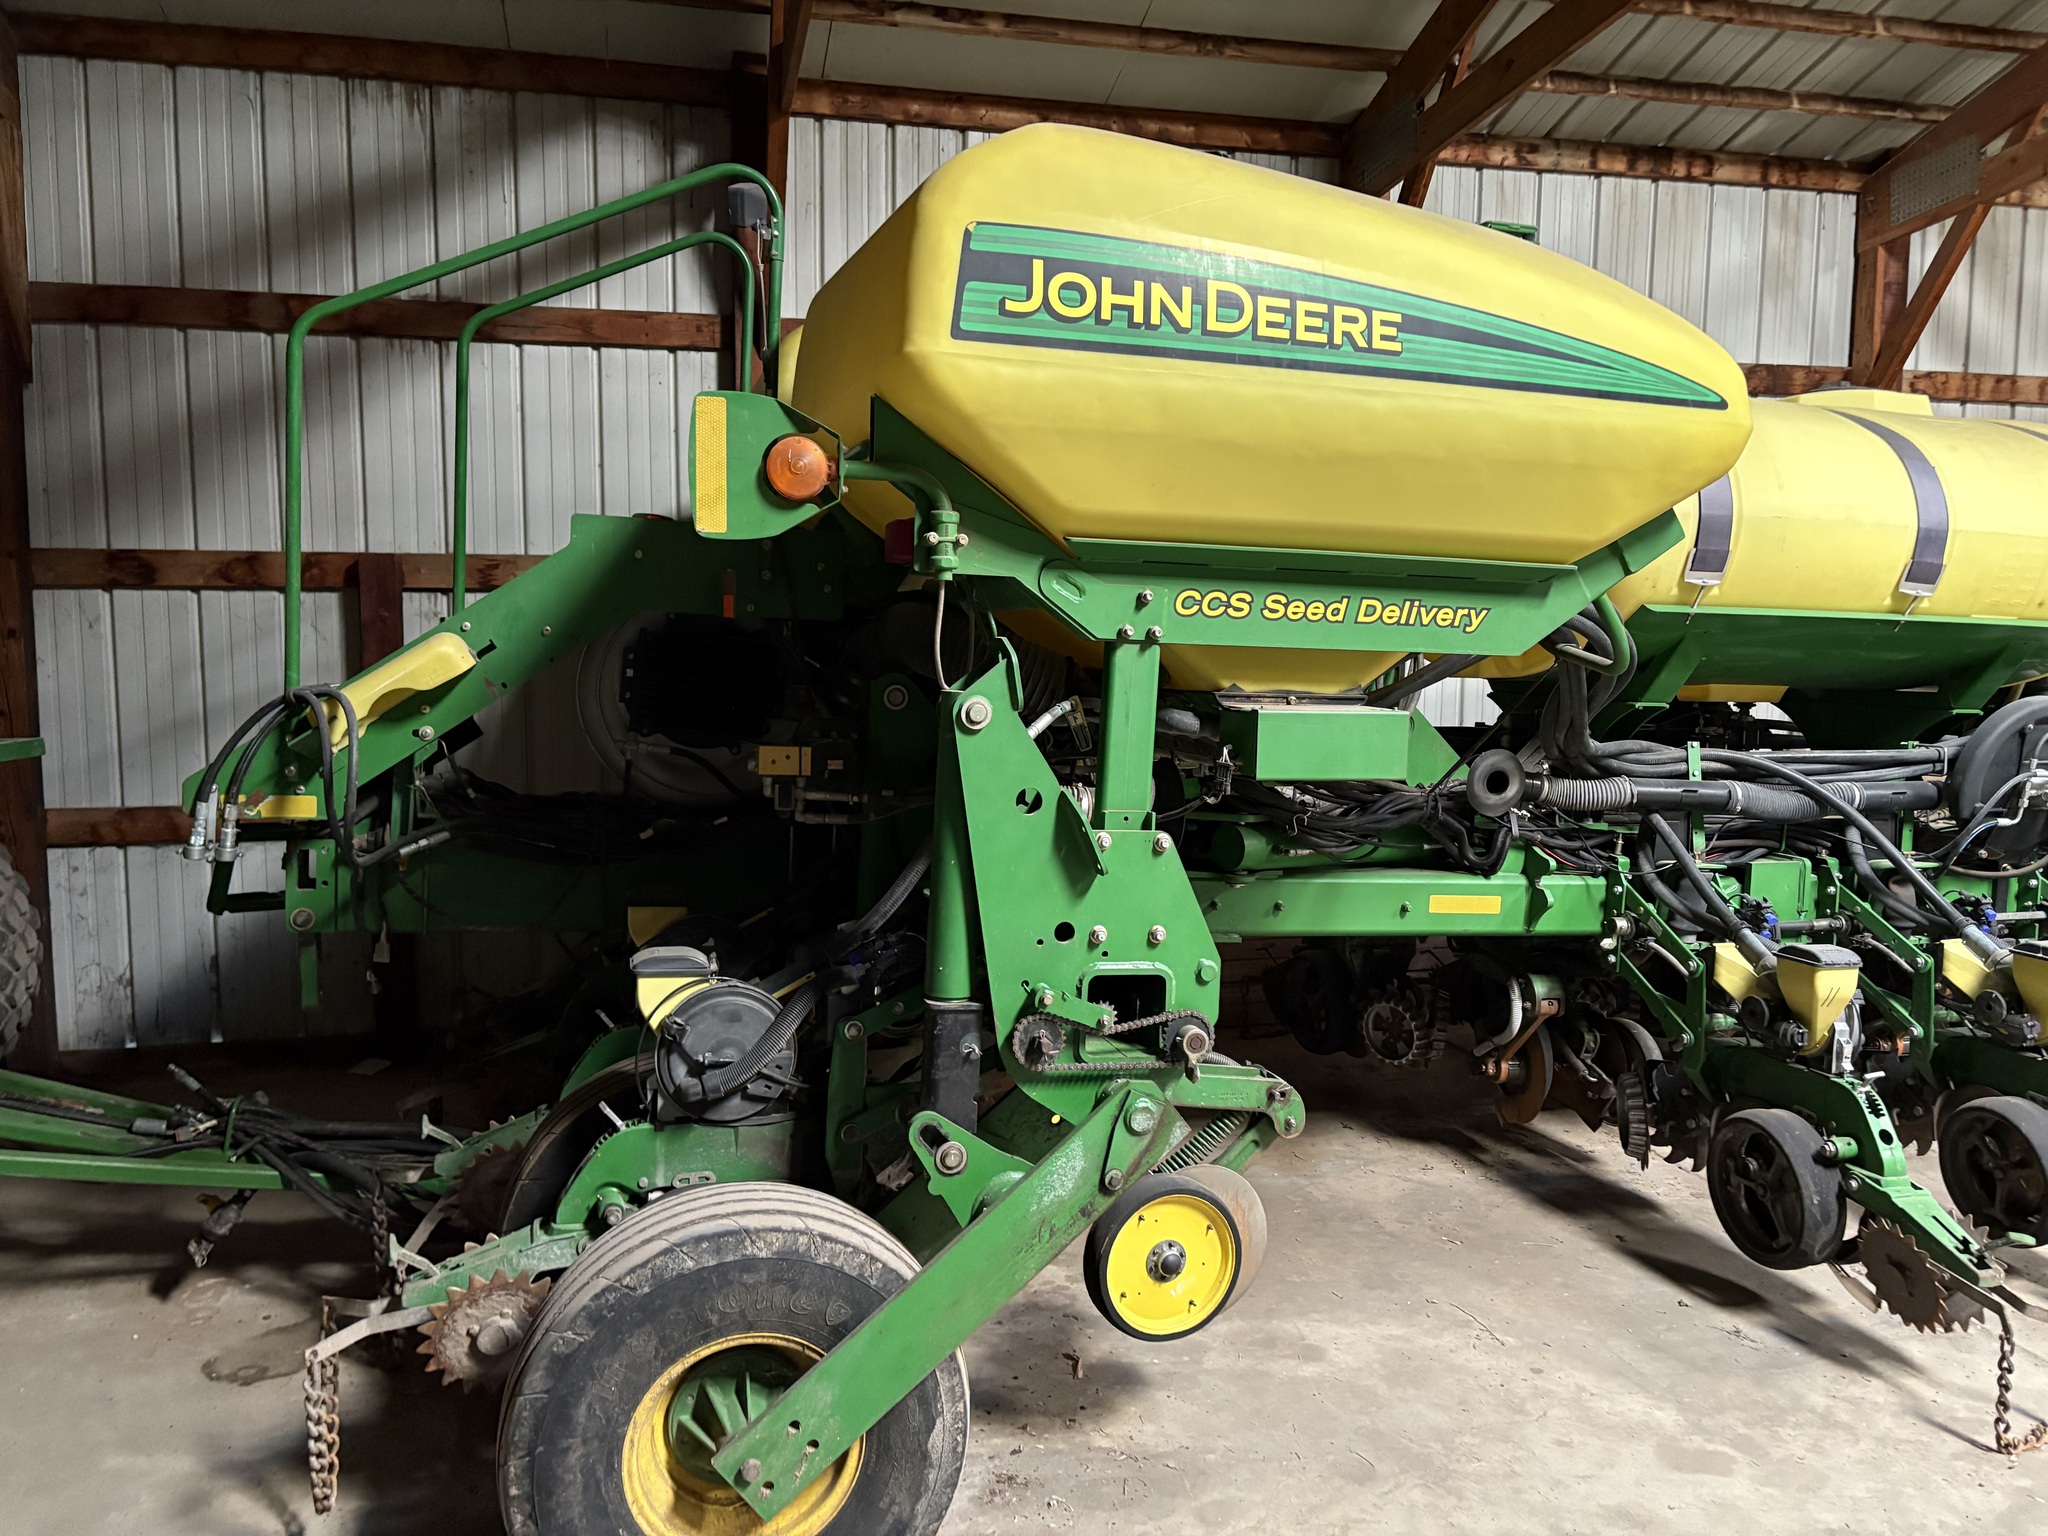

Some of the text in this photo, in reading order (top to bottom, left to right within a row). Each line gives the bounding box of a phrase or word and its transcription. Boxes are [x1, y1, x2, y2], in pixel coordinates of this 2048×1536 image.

[1001, 258, 1403, 354] JOHN DEERE
[1174, 589, 1490, 633] CCS Seed Delivery
